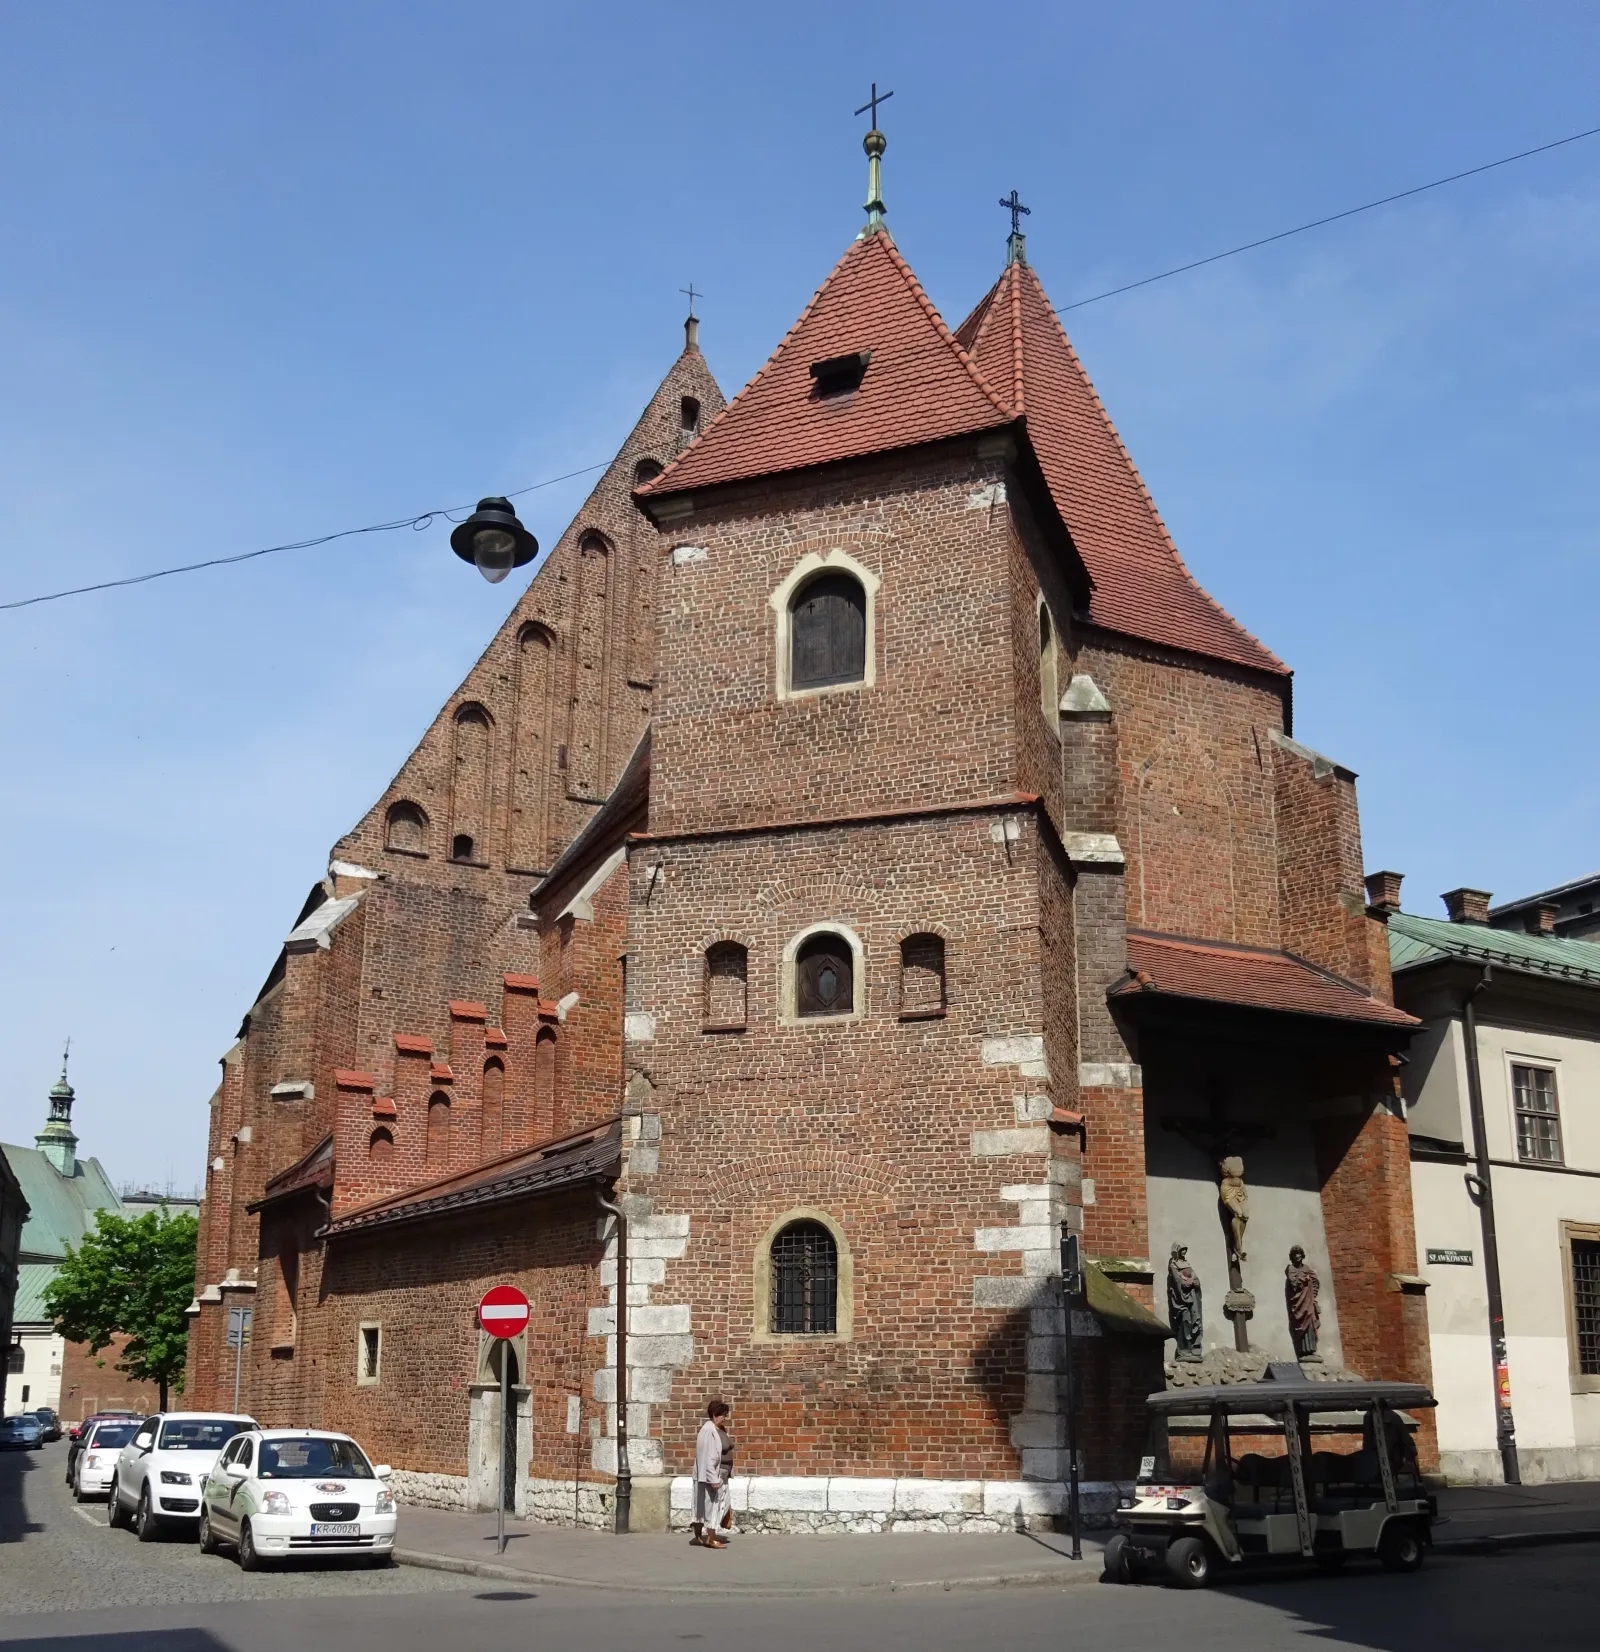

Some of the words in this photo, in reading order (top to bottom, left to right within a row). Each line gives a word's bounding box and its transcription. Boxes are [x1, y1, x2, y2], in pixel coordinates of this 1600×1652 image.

[1142, 1457, 1154, 1468] 186
[1381, 1457, 1394, 1501] TOUR
[316, 1525, 329, 1534] KR
[331, 1525, 357, 1534] 6002K
